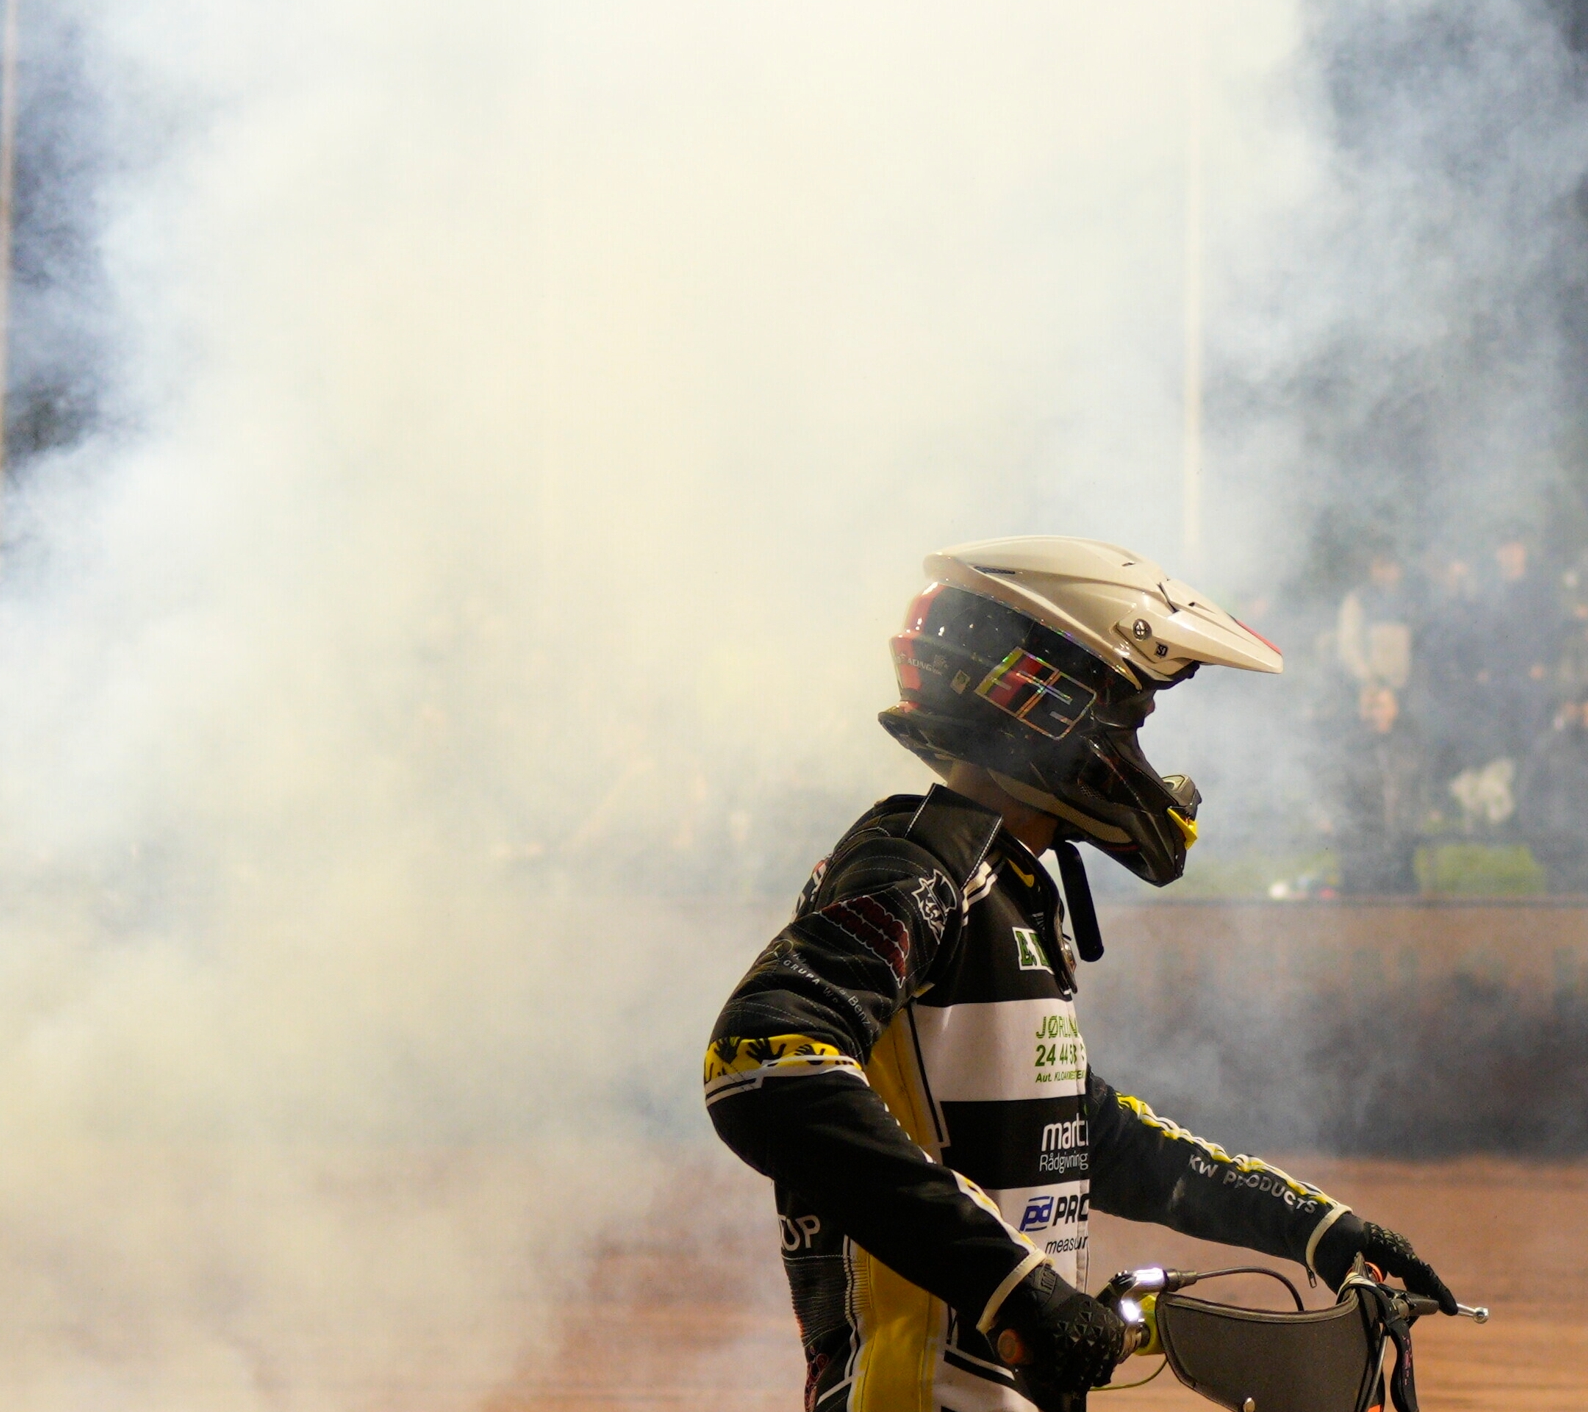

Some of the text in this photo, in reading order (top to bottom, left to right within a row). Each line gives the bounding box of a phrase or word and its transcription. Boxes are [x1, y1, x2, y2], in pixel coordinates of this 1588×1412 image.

[783, 958, 820, 986] GRUPA
[1035, 1043, 1056, 1067] 24
[1188, 1154, 1318, 1214] KW PRODUCTS
